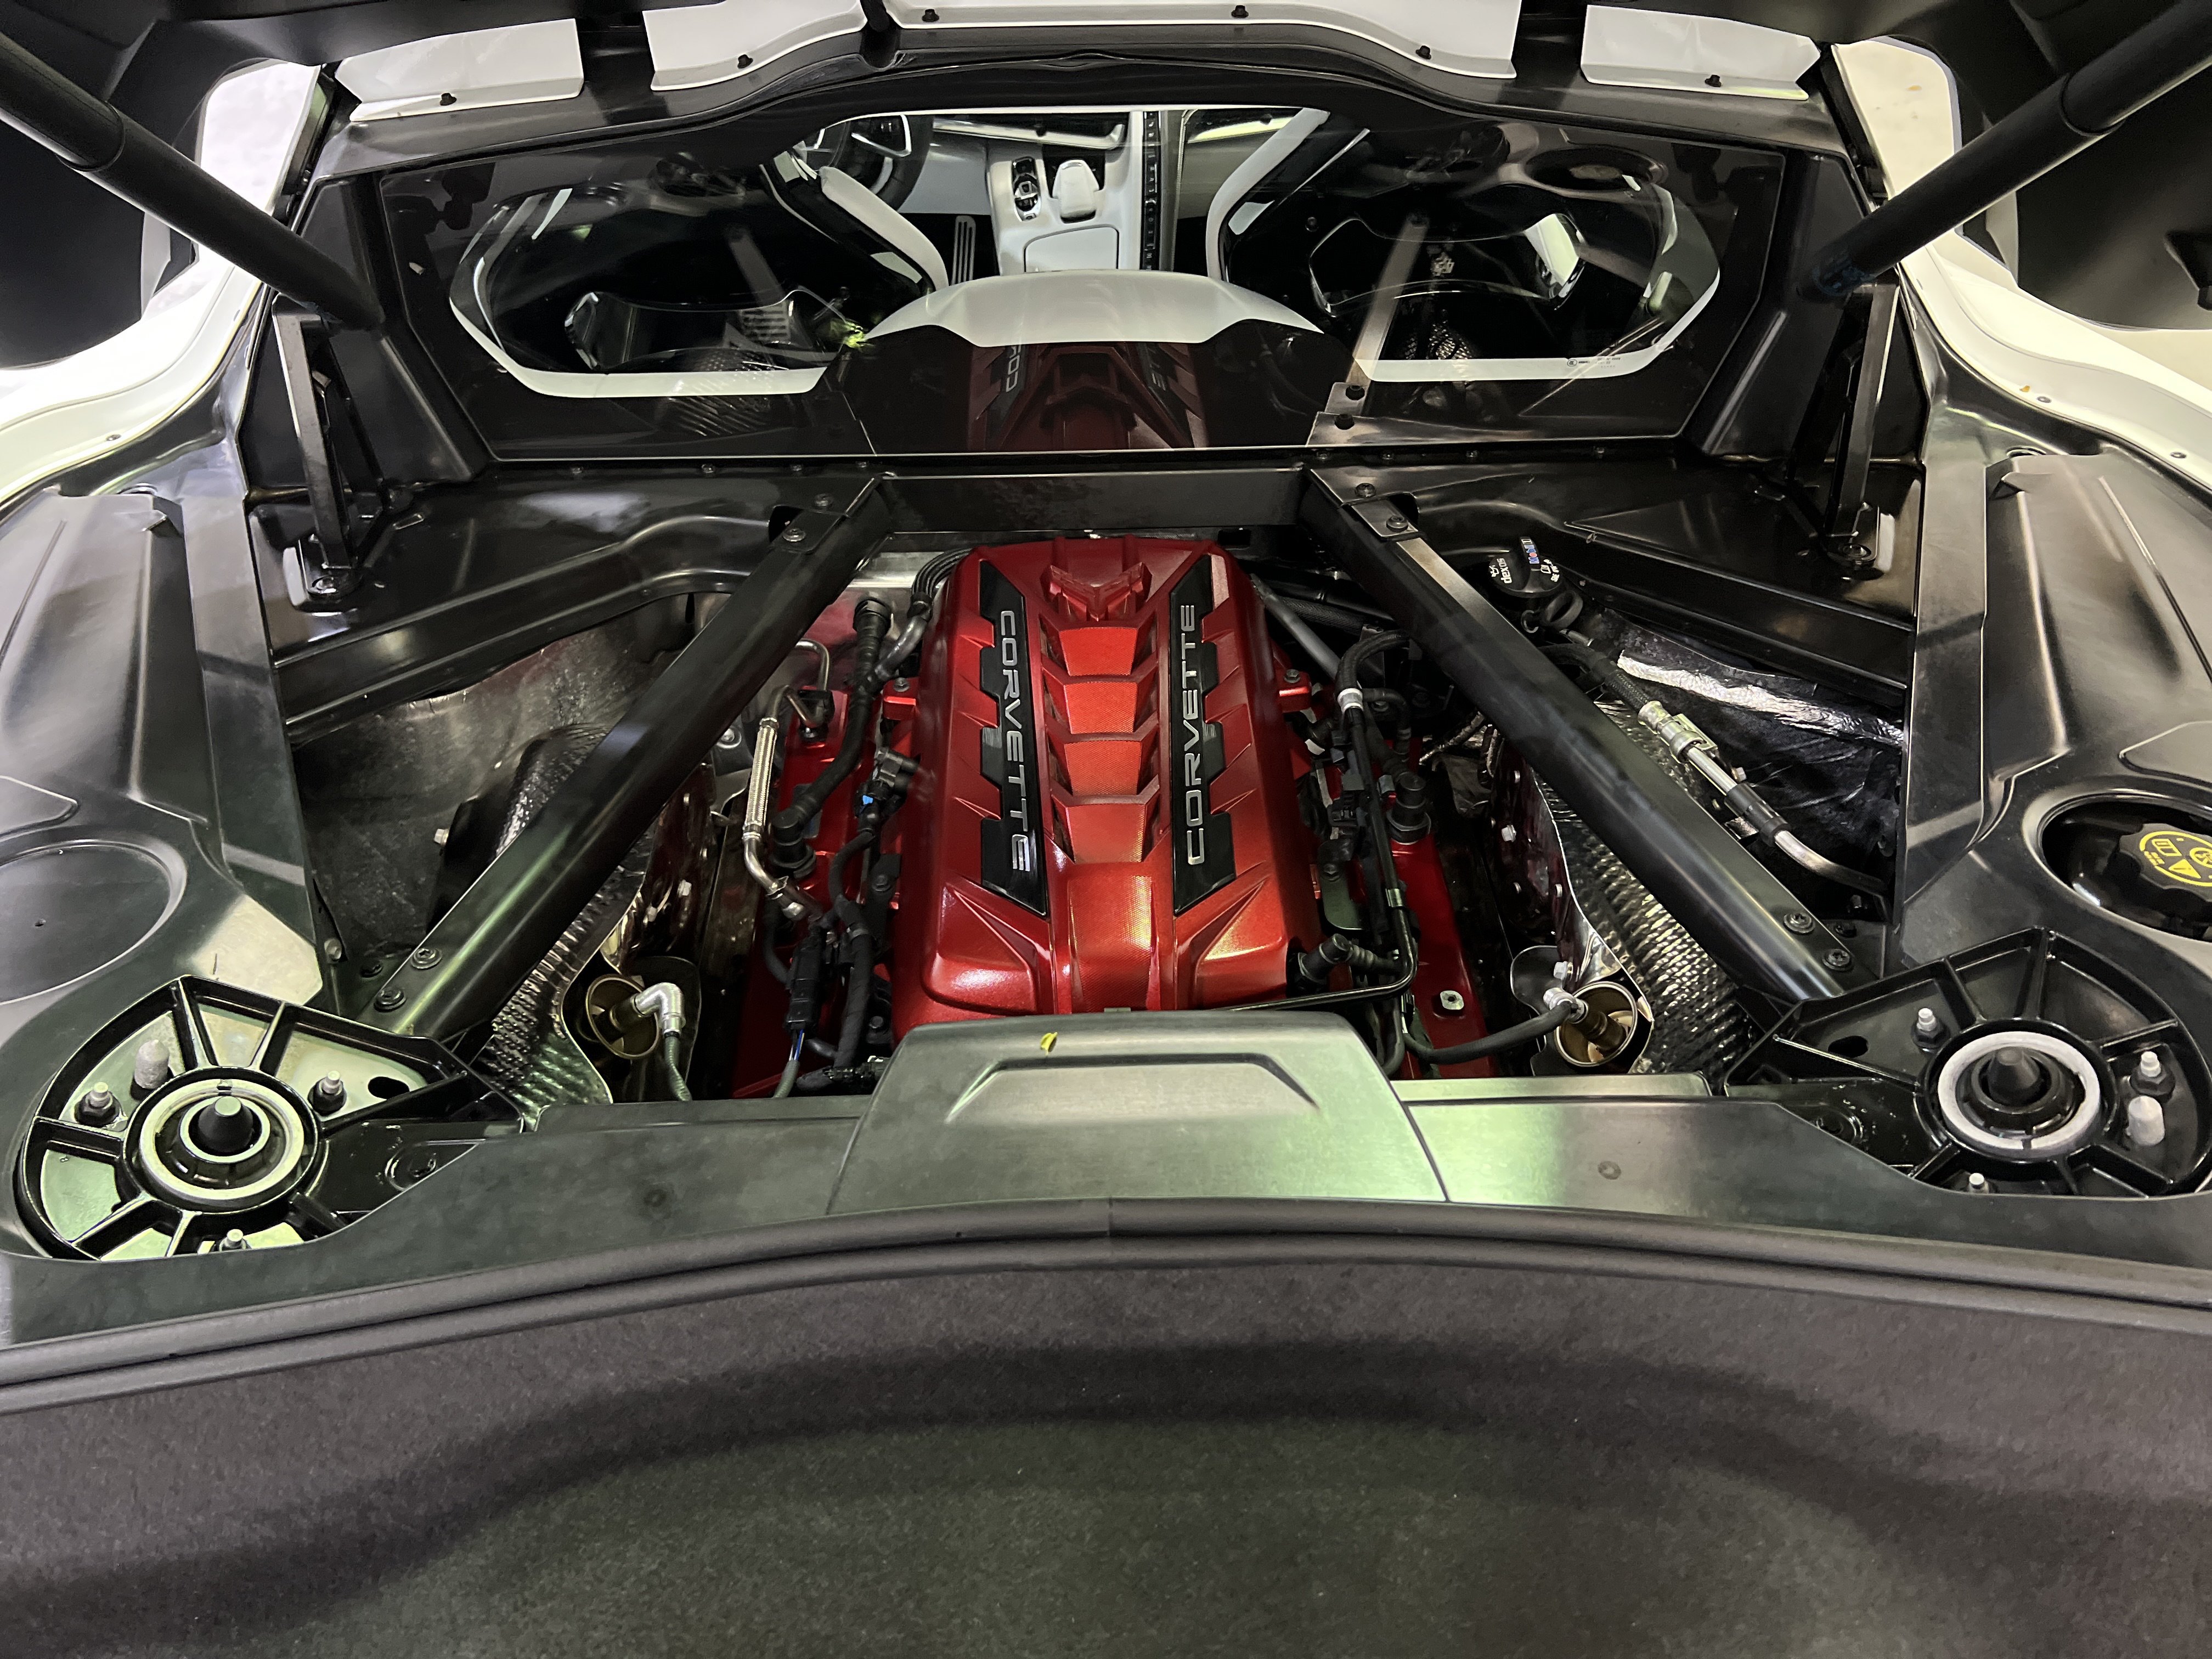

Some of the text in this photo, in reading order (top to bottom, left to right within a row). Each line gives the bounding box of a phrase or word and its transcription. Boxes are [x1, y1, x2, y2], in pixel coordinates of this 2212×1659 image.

[1497, 558, 1513, 583] dexos
[1001, 610, 1031, 871] CORVETTE
[1180, 605, 1204, 865] CORVETTE
